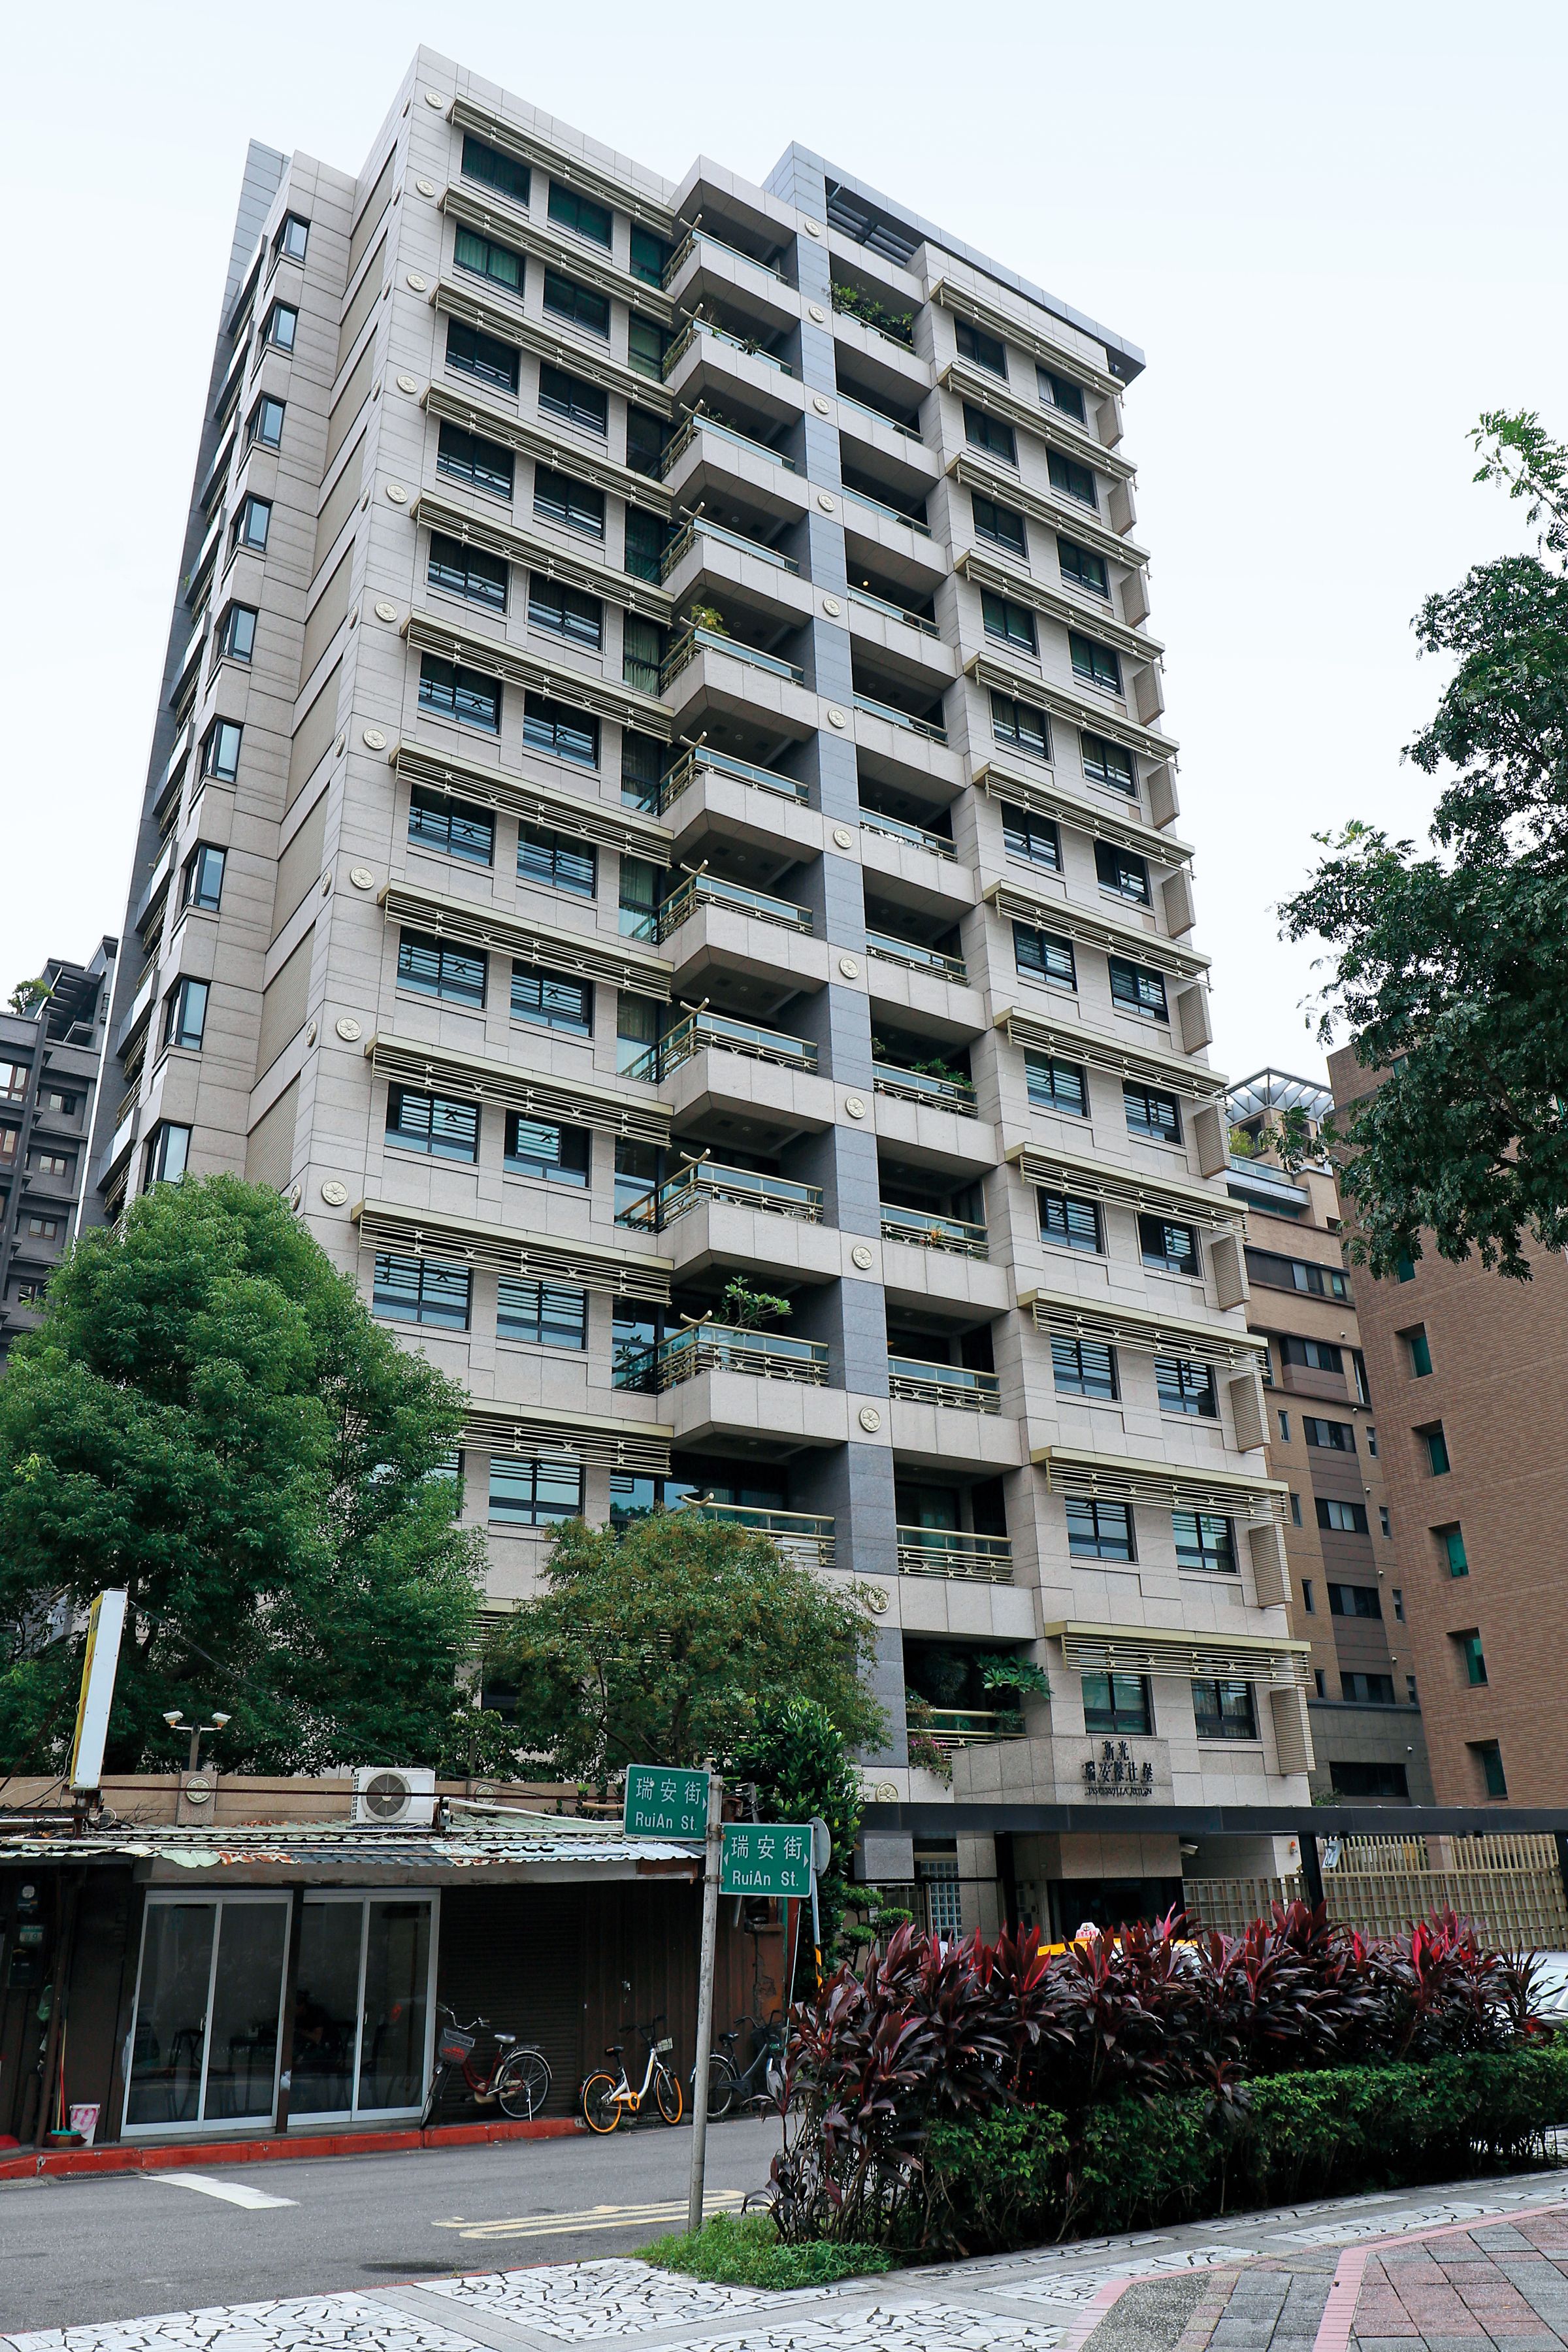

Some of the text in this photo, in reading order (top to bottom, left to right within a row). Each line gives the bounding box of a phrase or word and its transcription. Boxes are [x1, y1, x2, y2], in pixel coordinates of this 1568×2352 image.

[636, 1776, 701, 1805] 瑞安街
[635, 1811, 697, 1831] RuiAn St.
[731, 1835, 802, 1860] 瑞安街
[732, 1870, 798, 1887] RuiAn St.
